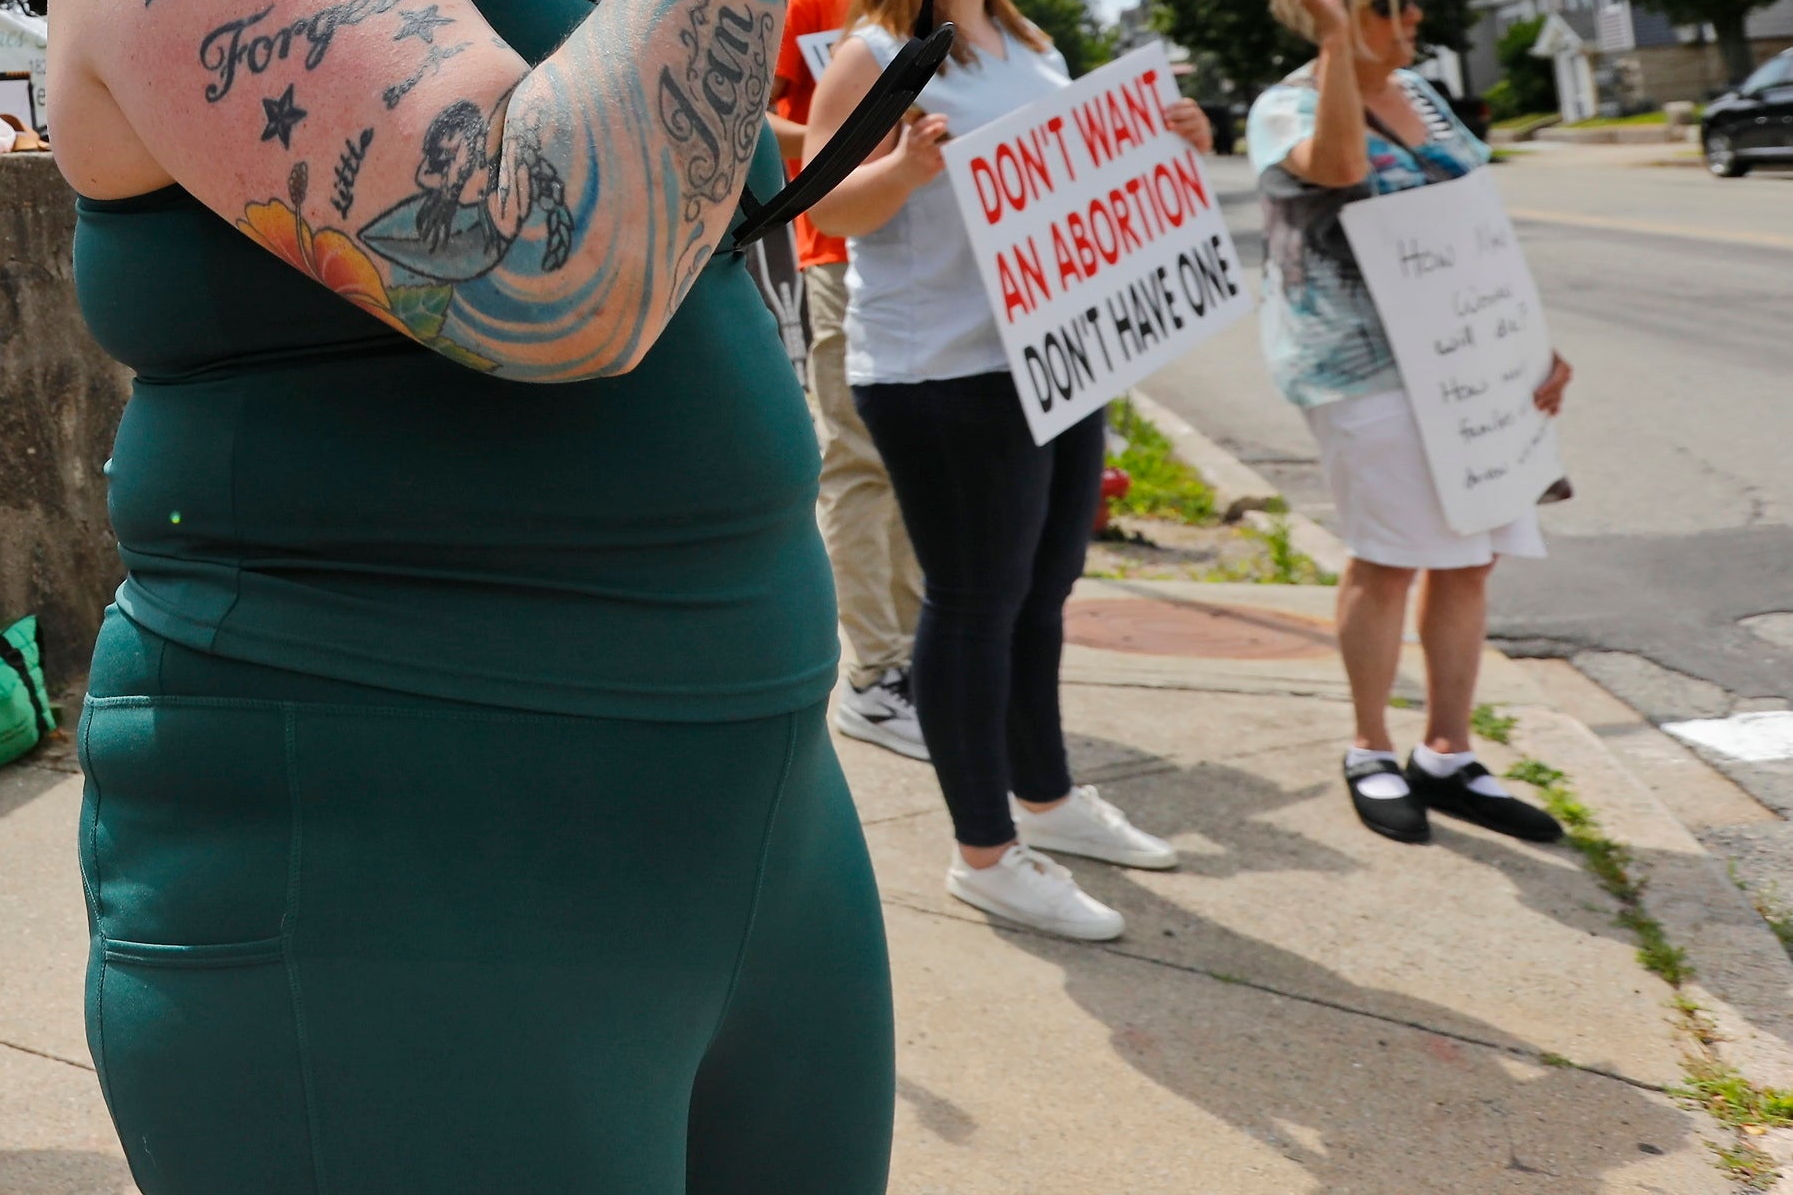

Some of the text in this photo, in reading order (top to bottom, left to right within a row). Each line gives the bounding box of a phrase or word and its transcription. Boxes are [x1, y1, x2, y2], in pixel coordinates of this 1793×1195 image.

[969, 69, 1173, 226] DON'T WANT
[995, 148, 1211, 325] AN ABORTION
[1022, 235, 1239, 414] DON'T HAVE ONE
